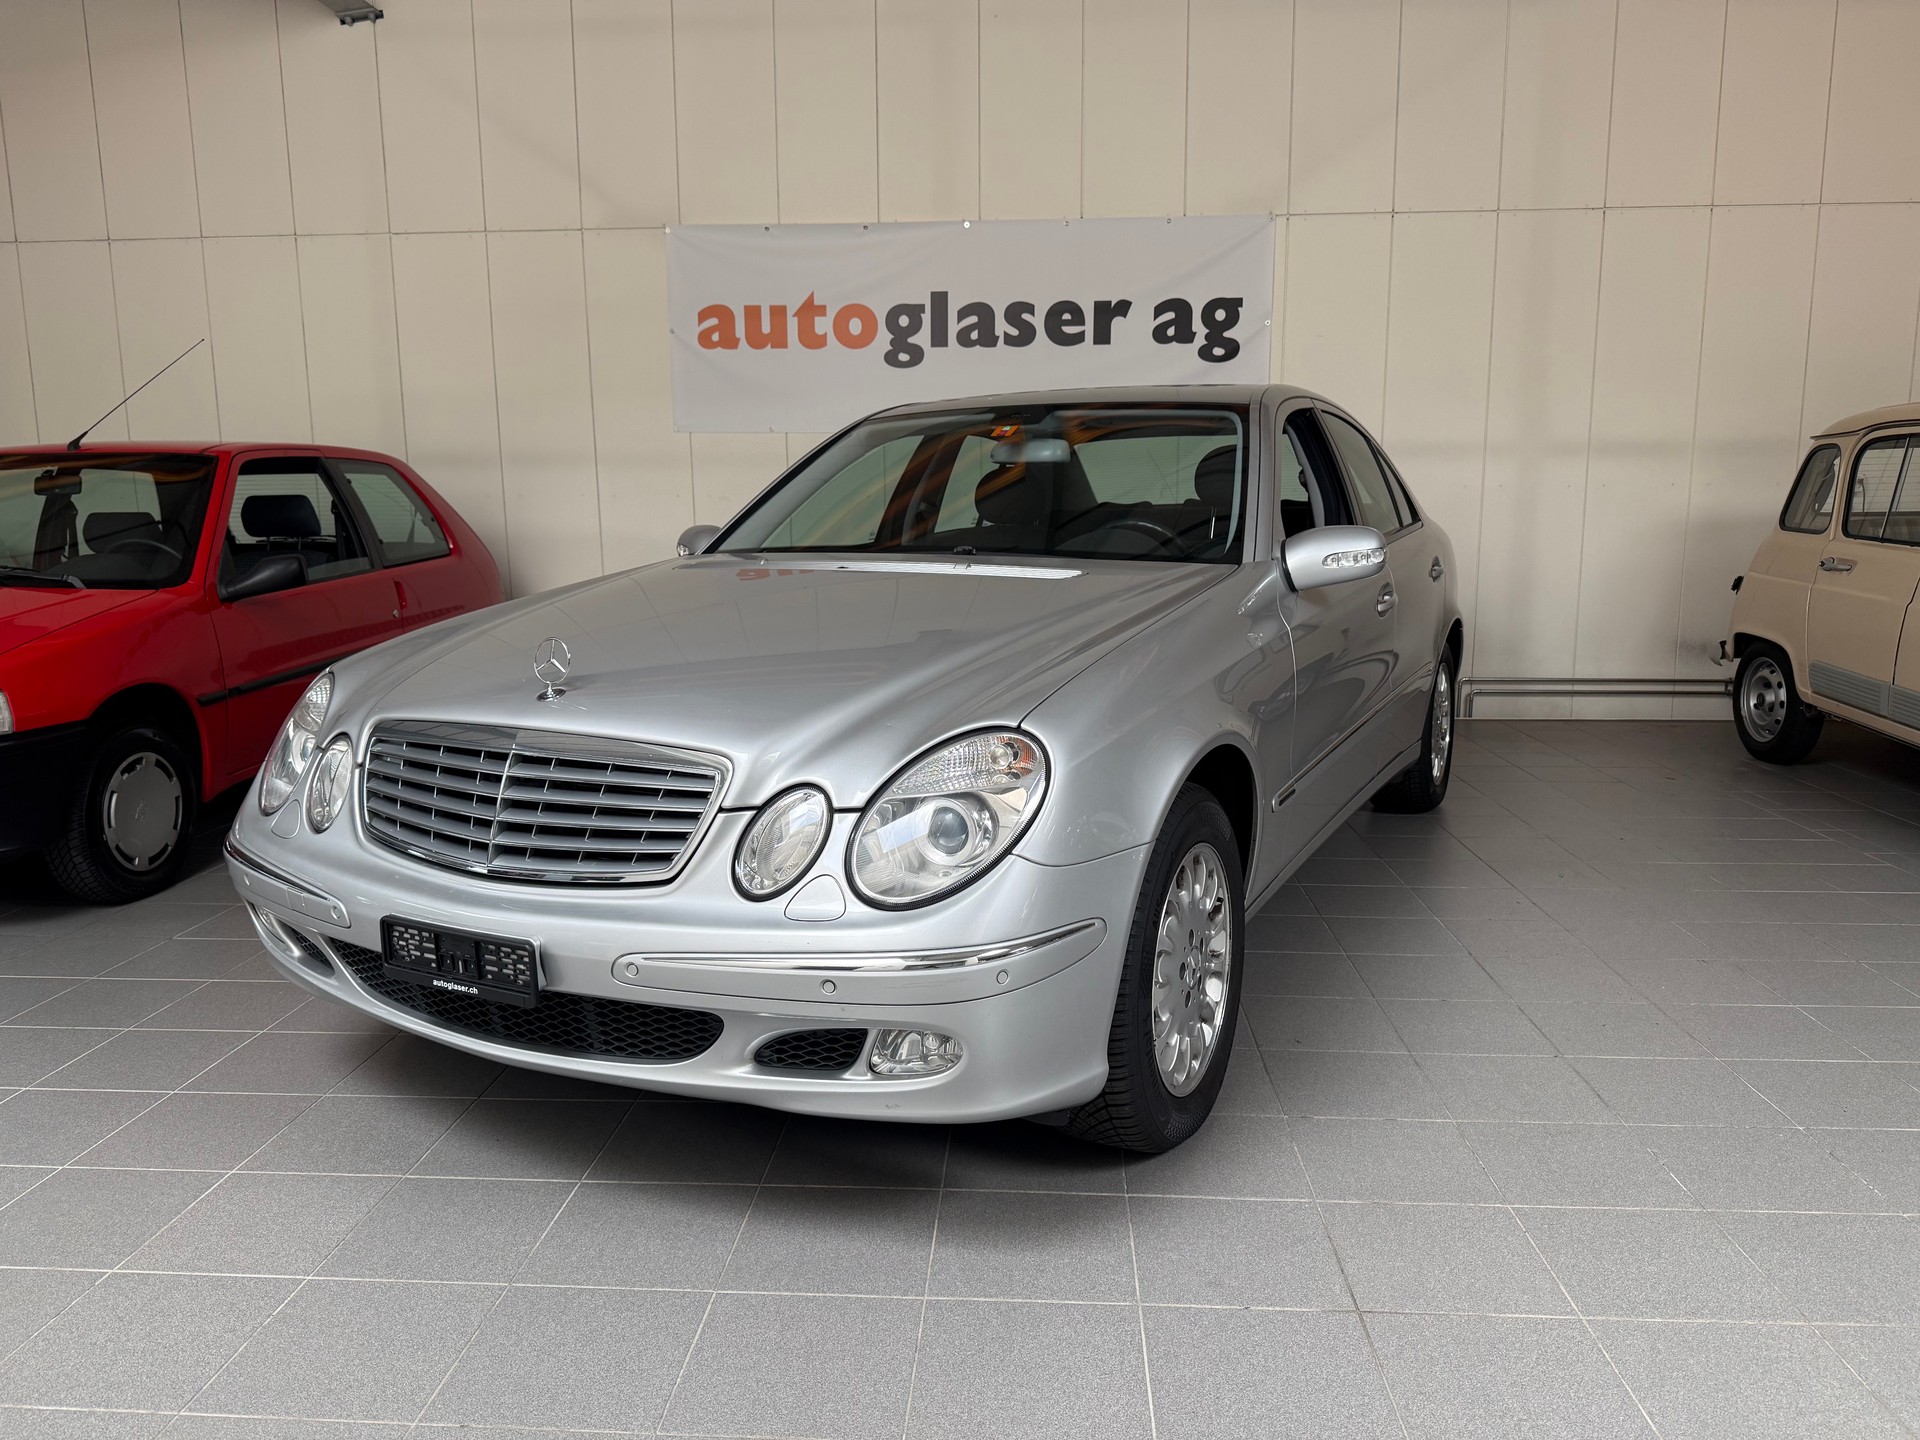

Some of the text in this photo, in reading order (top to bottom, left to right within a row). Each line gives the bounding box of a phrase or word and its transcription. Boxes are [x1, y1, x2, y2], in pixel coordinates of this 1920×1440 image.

[697, 291, 1243, 368] autoglaser ag
[432, 979, 479, 995] autoglaser.ch
